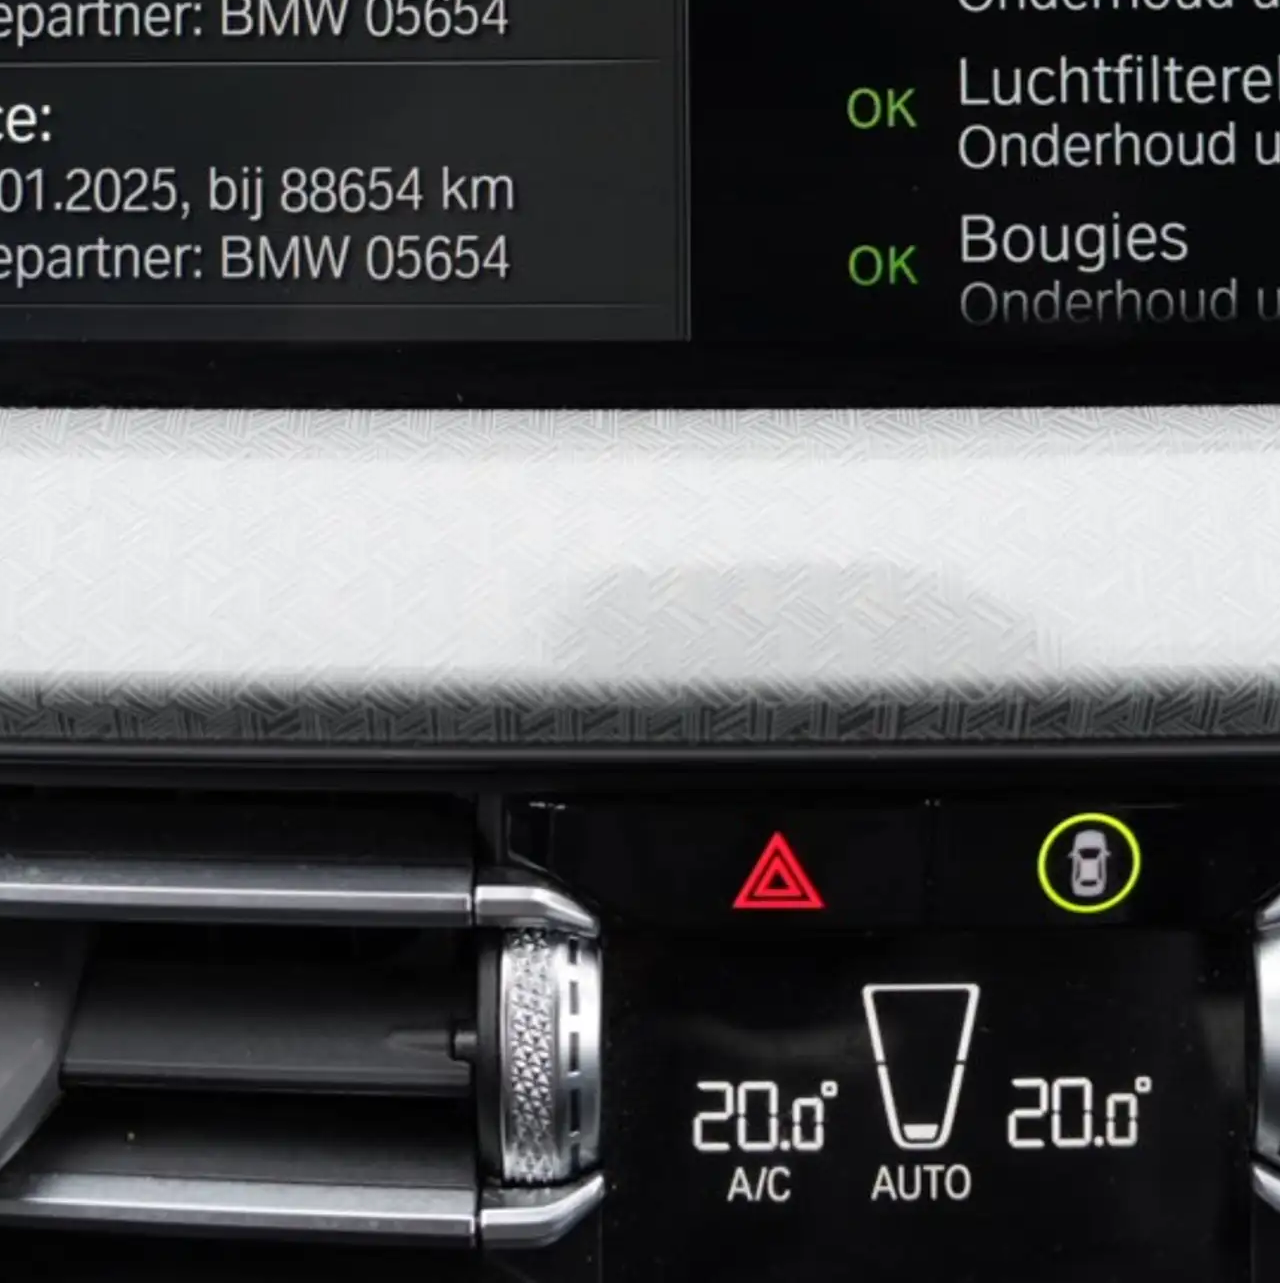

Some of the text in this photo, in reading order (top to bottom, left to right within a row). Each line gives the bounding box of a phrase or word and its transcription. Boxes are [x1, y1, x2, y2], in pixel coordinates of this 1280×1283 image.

[848, 89, 915, 128] OK
[959, 122, 1235, 168] Onderhoud
[210, 167, 262, 220] bij
[281, 167, 422, 212] 88654
[443, 166, 513, 209] km
[222, 235, 350, 278] BMW
[367, 235, 509, 280] 05654
[961, 212, 1188, 272] Bougies
[850, 246, 916, 284] OK
[960, 277, 1236, 325] Onderhoud
[728, 1166, 790, 1201] A/C
[871, 1164, 971, 1200] AUTO
